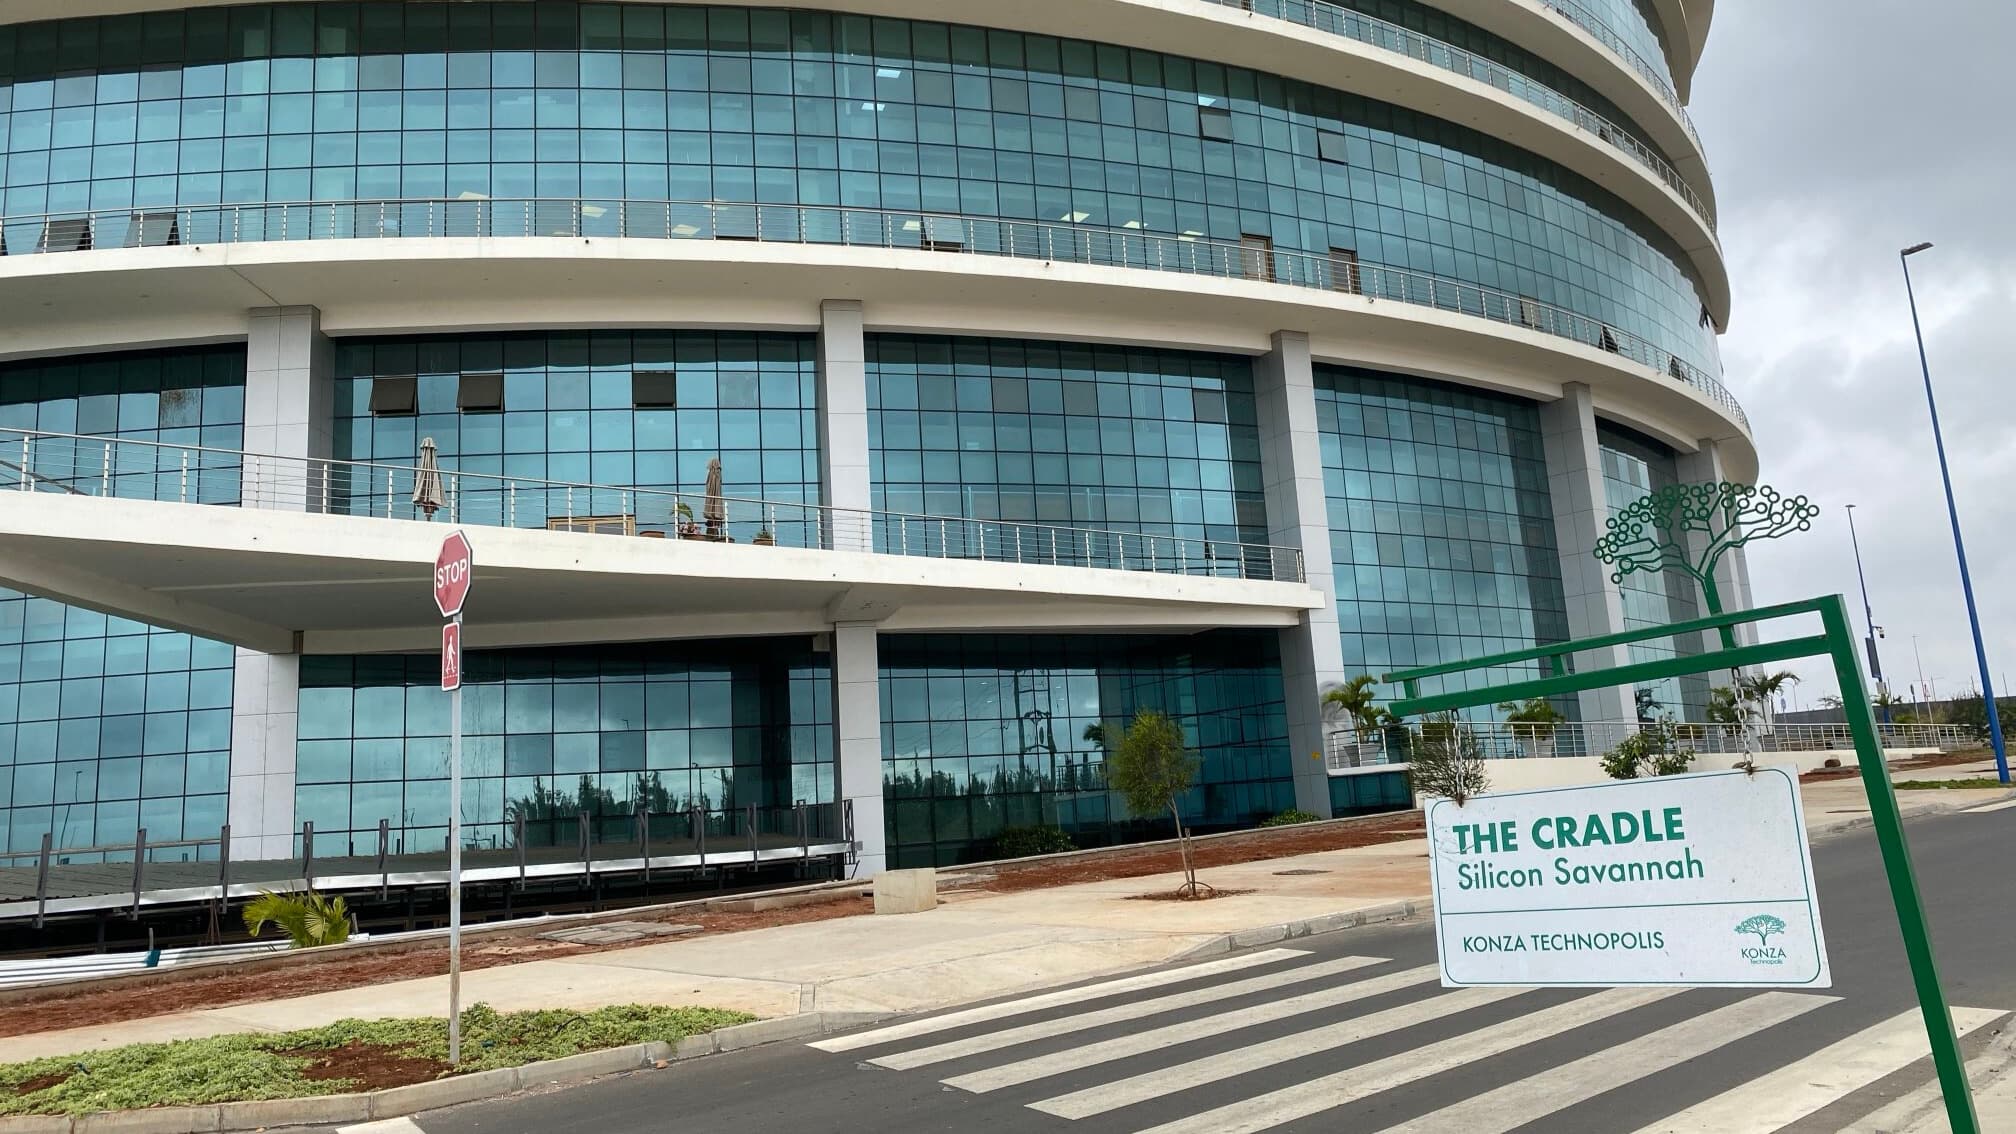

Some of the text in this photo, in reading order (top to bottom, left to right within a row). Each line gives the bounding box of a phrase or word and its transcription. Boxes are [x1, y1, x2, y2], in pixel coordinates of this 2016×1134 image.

[437, 559, 467, 588] STOP
[1452, 807, 1685, 855] THE CRADLE
[1458, 847, 1705, 890] Silicon Savannah
[1463, 931, 1665, 953] KONZA TECHNOPOLIS
[1741, 947, 1787, 959] KONZA
